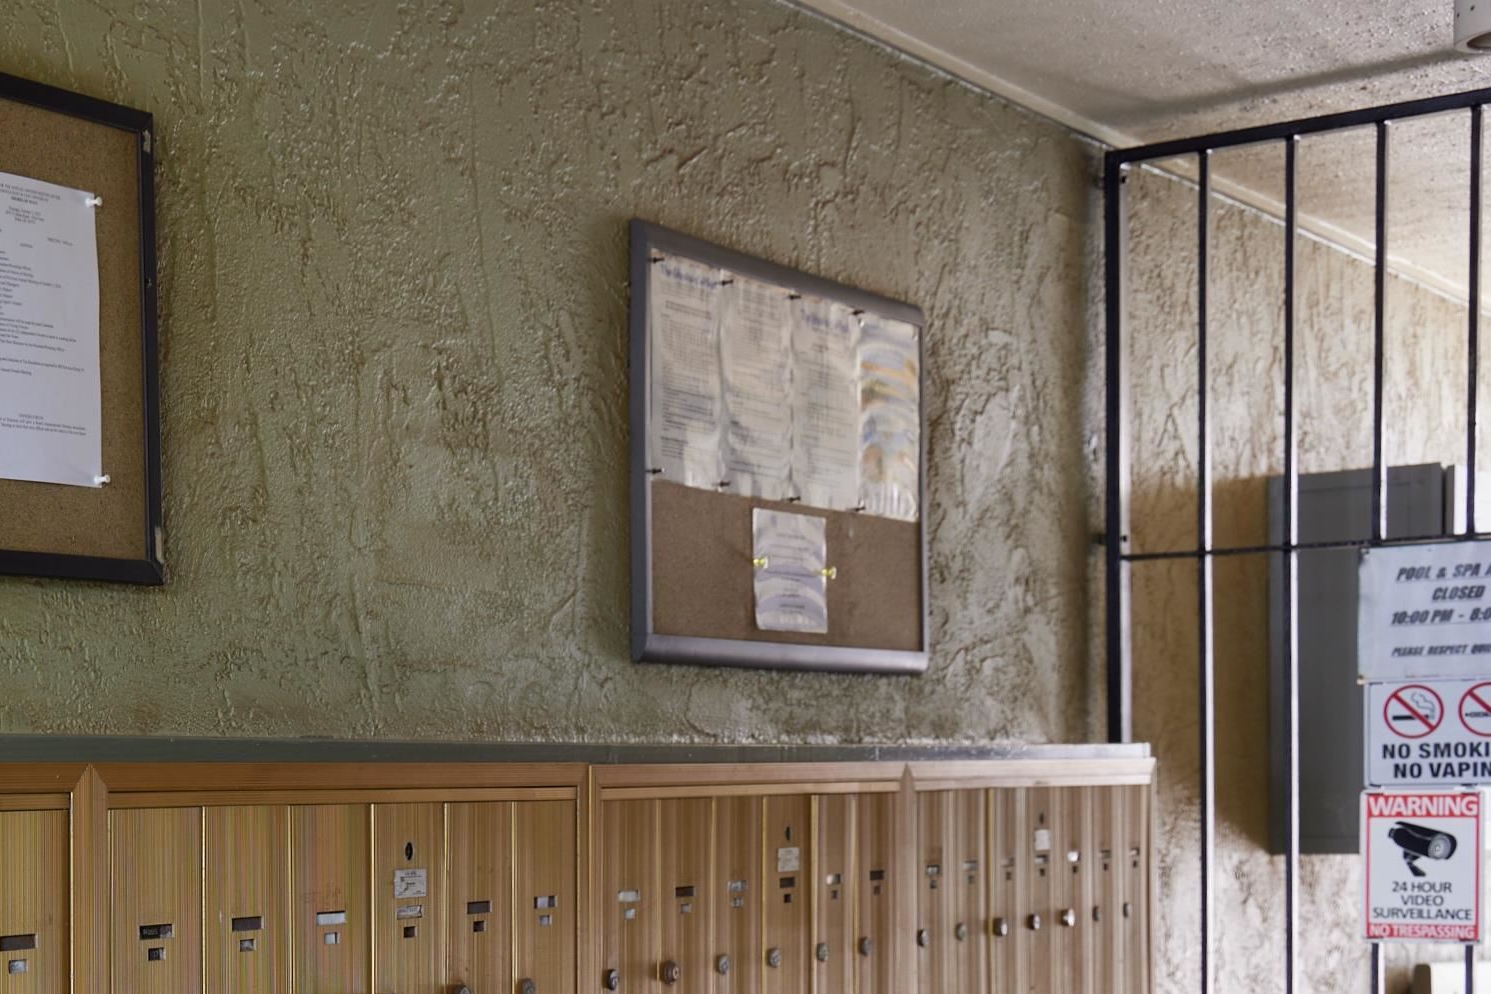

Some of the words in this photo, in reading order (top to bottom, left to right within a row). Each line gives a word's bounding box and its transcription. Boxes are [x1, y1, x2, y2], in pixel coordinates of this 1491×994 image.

[1396, 566, 1432, 581] POOL
[1436, 567, 1447, 579] &
[1453, 563, 1481, 577] SPA
[1431, 585, 1486, 601] CLOSED
[1391, 610, 1430, 625] 10:00
[1430, 609, 1454, 623] PM
[1391, 646, 1425, 657] PLEASE
[1427, 644, 1469, 656] RESPECT
[1382, 743, 1411, 759] NO
[1393, 763, 1423, 779] NO
[1369, 796, 1478, 817] WARNING
[1392, 881, 1408, 892] 24
[1411, 881, 1453, 893] HOUR
[1401, 894, 1445, 906] VIDEO
[1372, 907, 1473, 920] SURVEILLANCE
[1370, 925, 1390, 938] NO
[1391, 925, 1476, 939] TRESPASSING
